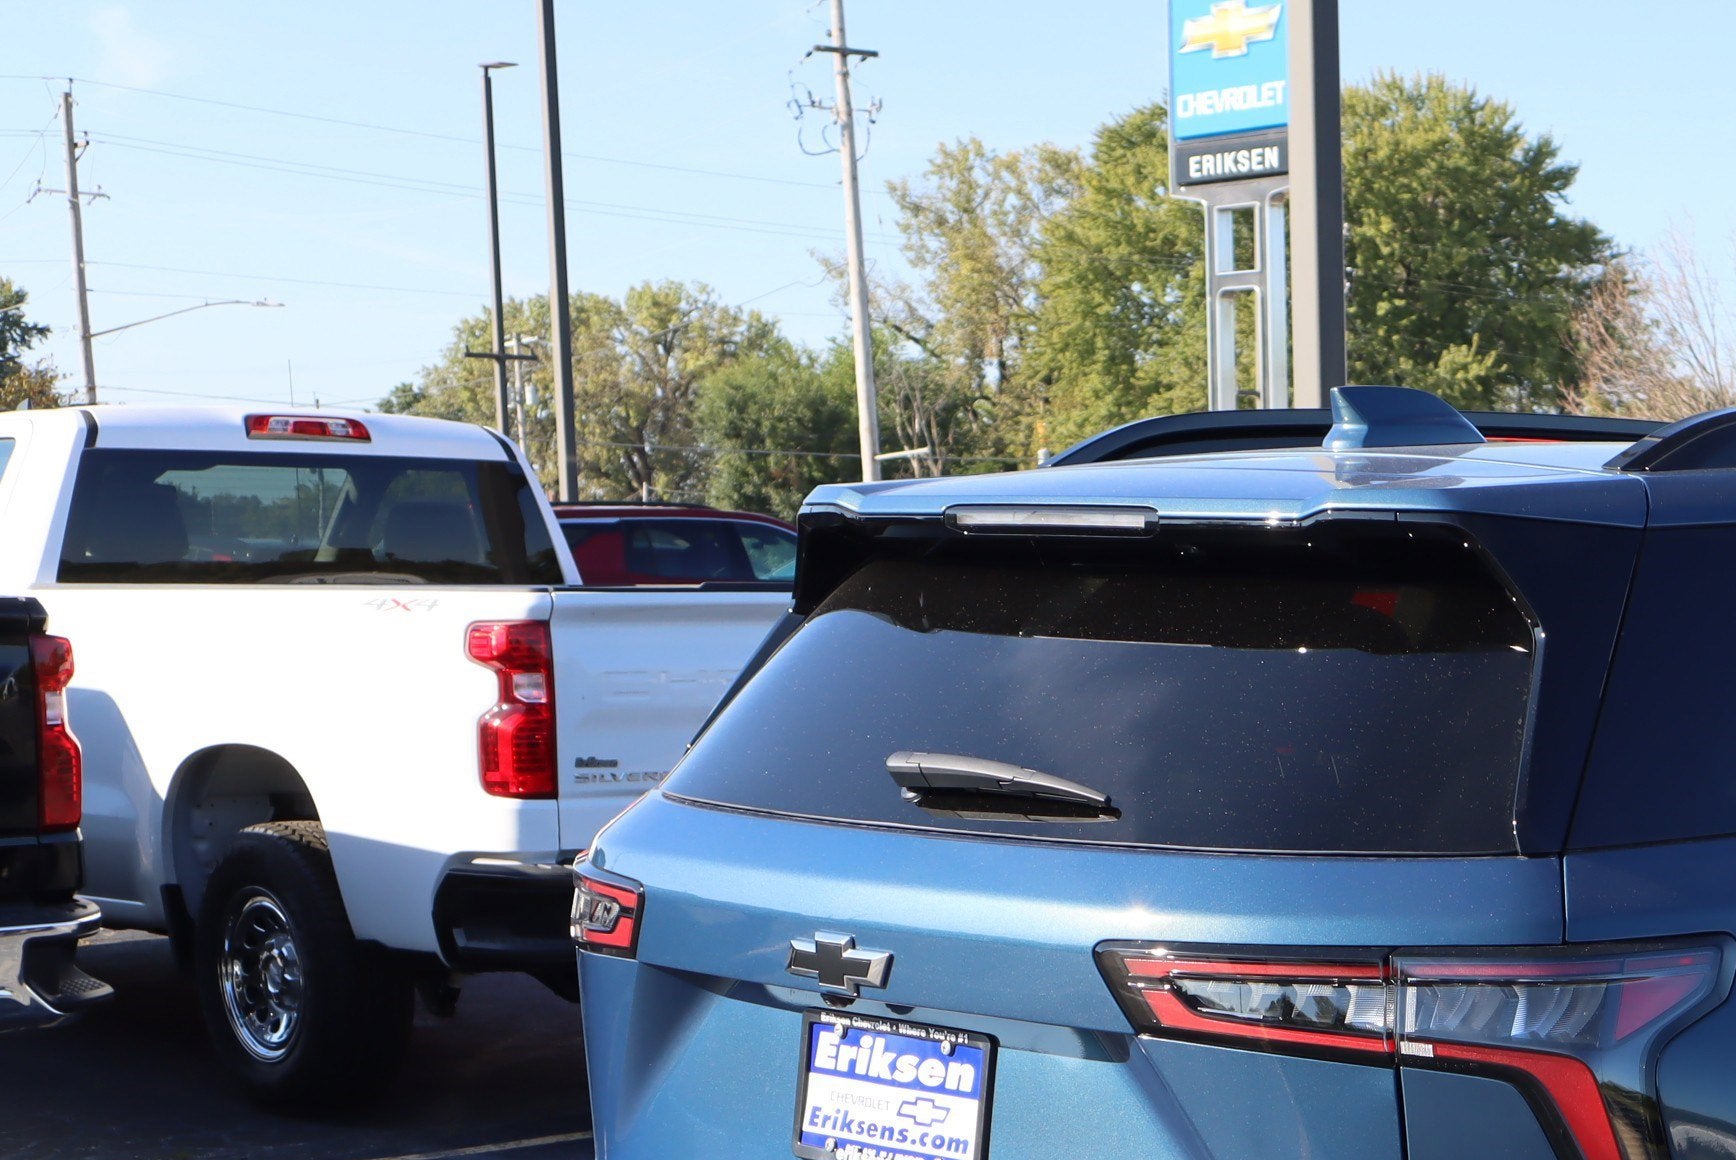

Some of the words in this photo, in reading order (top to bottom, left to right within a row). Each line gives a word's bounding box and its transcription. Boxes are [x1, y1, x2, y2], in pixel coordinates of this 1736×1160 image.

[1176, 80, 1286, 119] CHEVROLET
[1188, 146, 1280, 180] ERIKSEN
[820, 1012, 851, 1026] Eriksen
[852, 1016, 892, 1032] Chevrolet
[898, 1023, 927, 1038] Where
[928, 1027, 956, 1043] You're
[957, 1033, 969, 1045] #1
[814, 1031, 976, 1093] Eriksen
[830, 1090, 891, 1111] CHEVROLET
[808, 1105, 969, 1155] Eriksens.com
